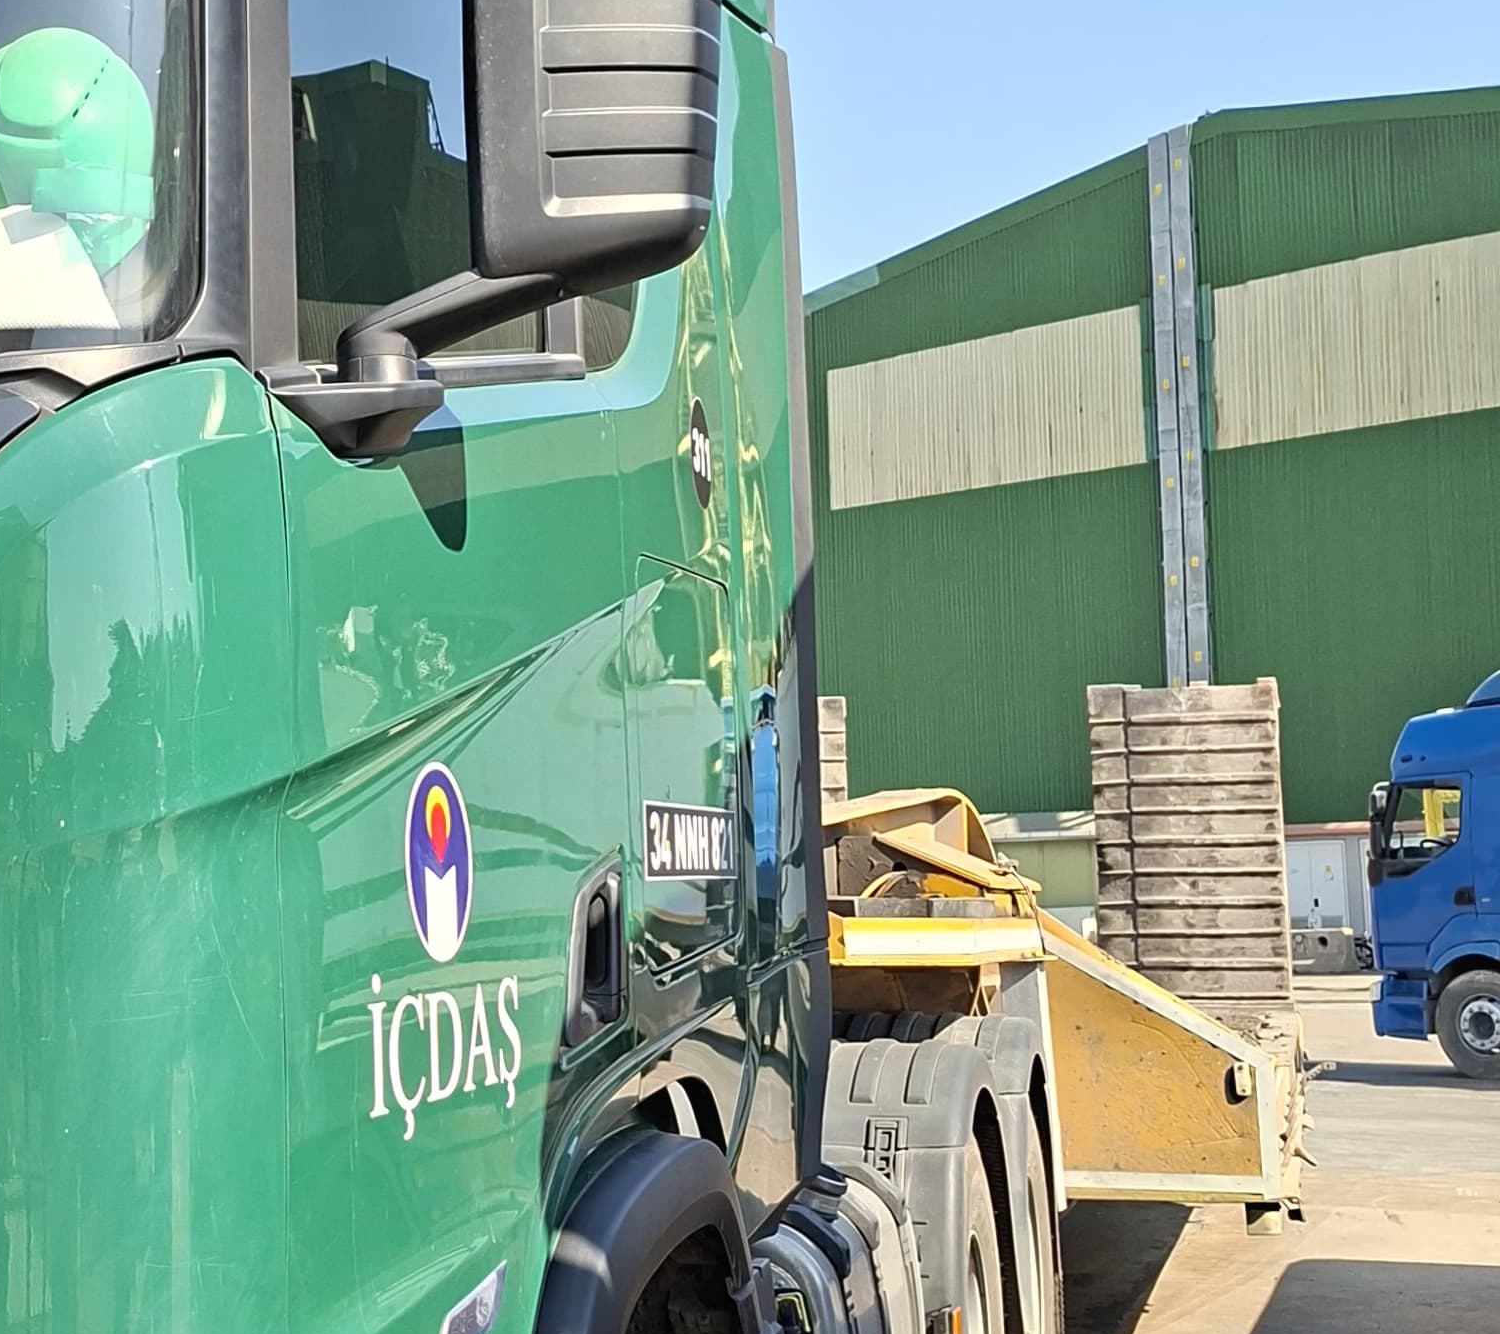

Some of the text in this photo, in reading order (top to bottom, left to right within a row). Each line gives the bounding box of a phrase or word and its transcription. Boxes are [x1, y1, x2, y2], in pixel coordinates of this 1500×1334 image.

[692, 427, 712, 482] 311
[650, 810, 734, 871] 34 NNH 821
[367, 973, 522, 1141] İÇDAŞ
